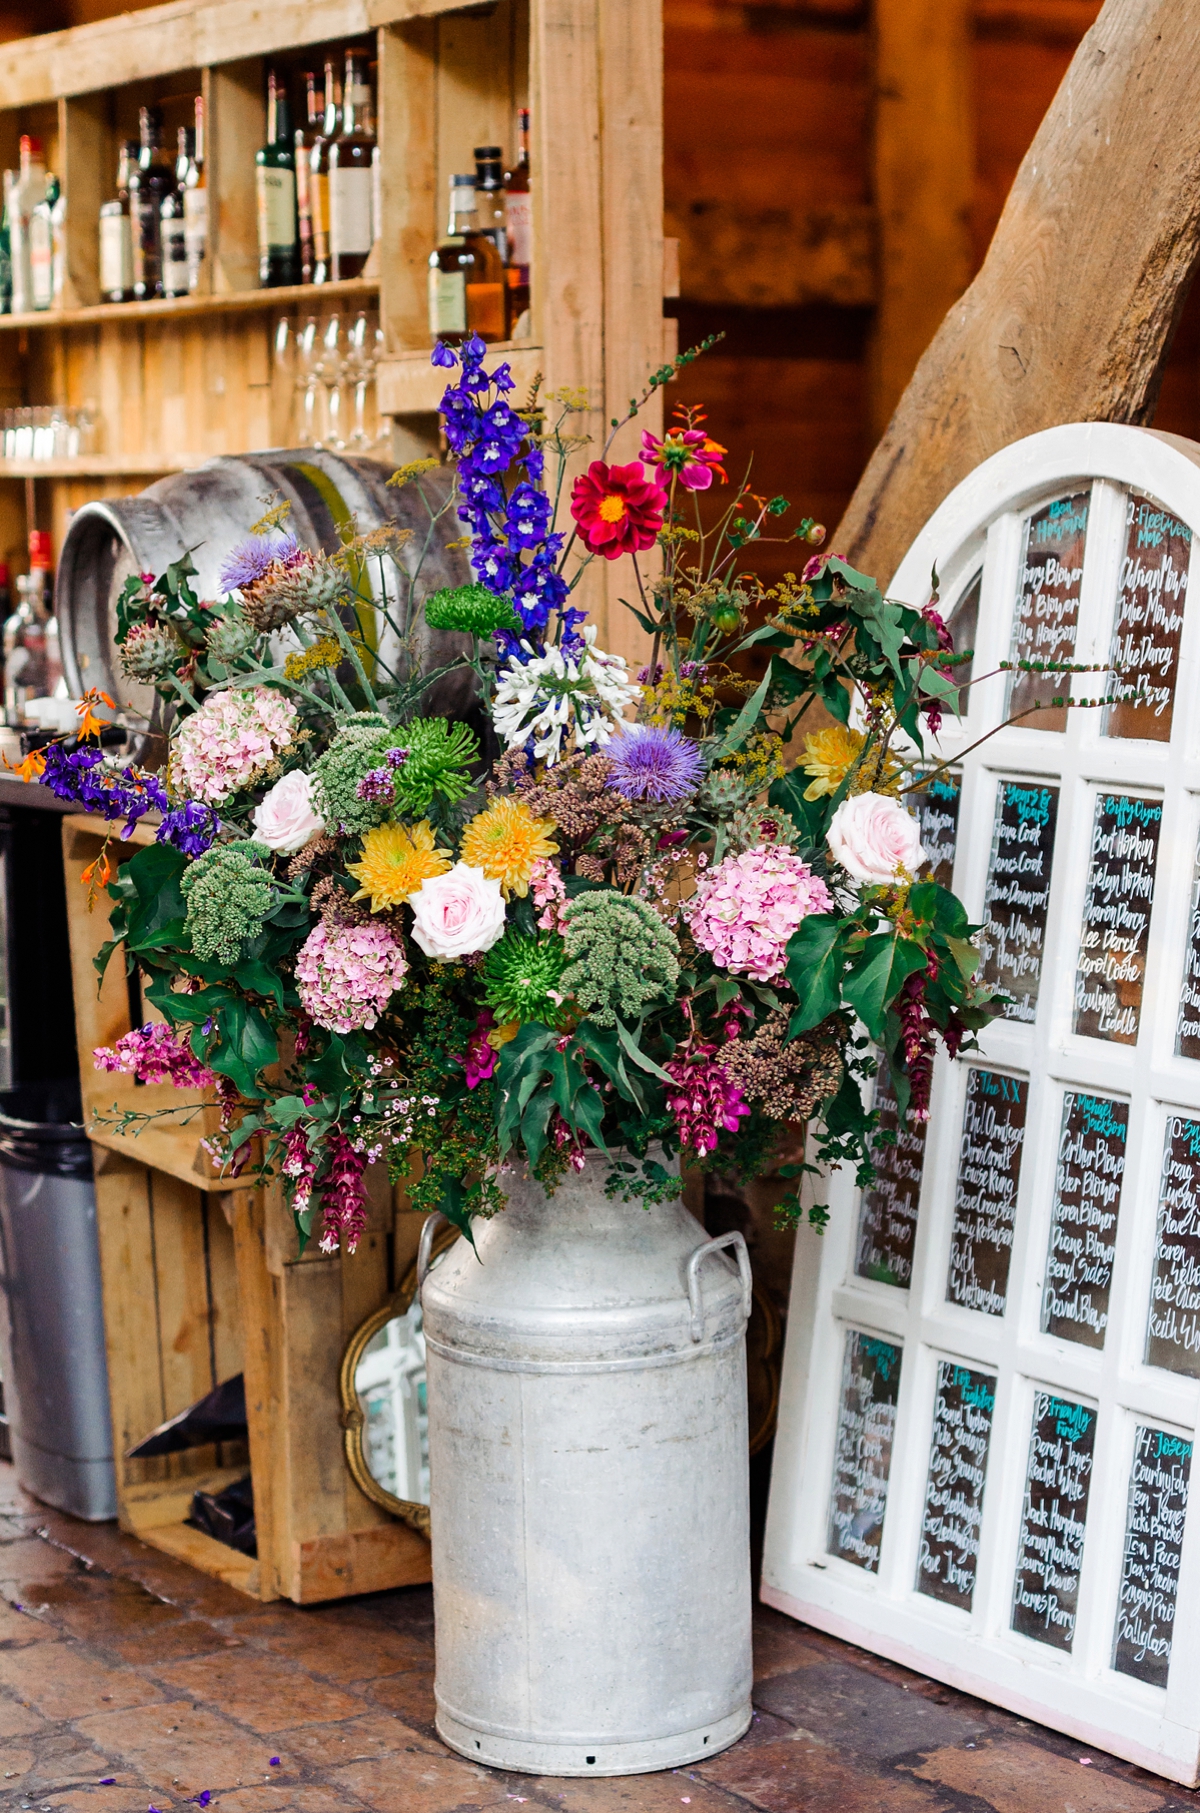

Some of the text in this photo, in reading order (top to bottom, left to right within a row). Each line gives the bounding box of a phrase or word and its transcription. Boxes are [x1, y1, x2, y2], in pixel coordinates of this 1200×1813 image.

[1105, 796, 1134, 827] Biffy
[1134, 800, 1163, 827] Clyro
[1017, 822, 1041, 846] Cook
[1091, 825, 1117, 859] Bert
[1116, 826, 1154, 865] Hopkin
[1017, 850, 1043, 876] Cook
[1087, 861, 1121, 903] Evelyn
[1121, 862, 1153, 904] Hopkin
[1080, 927, 1101, 948] Lee
[1077, 952, 1141, 982] Carol Cooke
[1075, 980, 1117, 1015] Pauline
[1098, 1007, 1137, 1035] Liddle
[1176, 1011, 1200, 1039] Caro
[979, 1071, 1000, 1095] The
[1082, 1112, 1126, 1143] Jackson
[1080, 1293, 1108, 1334] Blowe
[1148, 1305, 1181, 1345] Keith
[1150, 1515, 1184, 1545] Bricke
[1153, 1540, 1181, 1568] Pace
[1151, 1593, 1176, 1622] Prio
